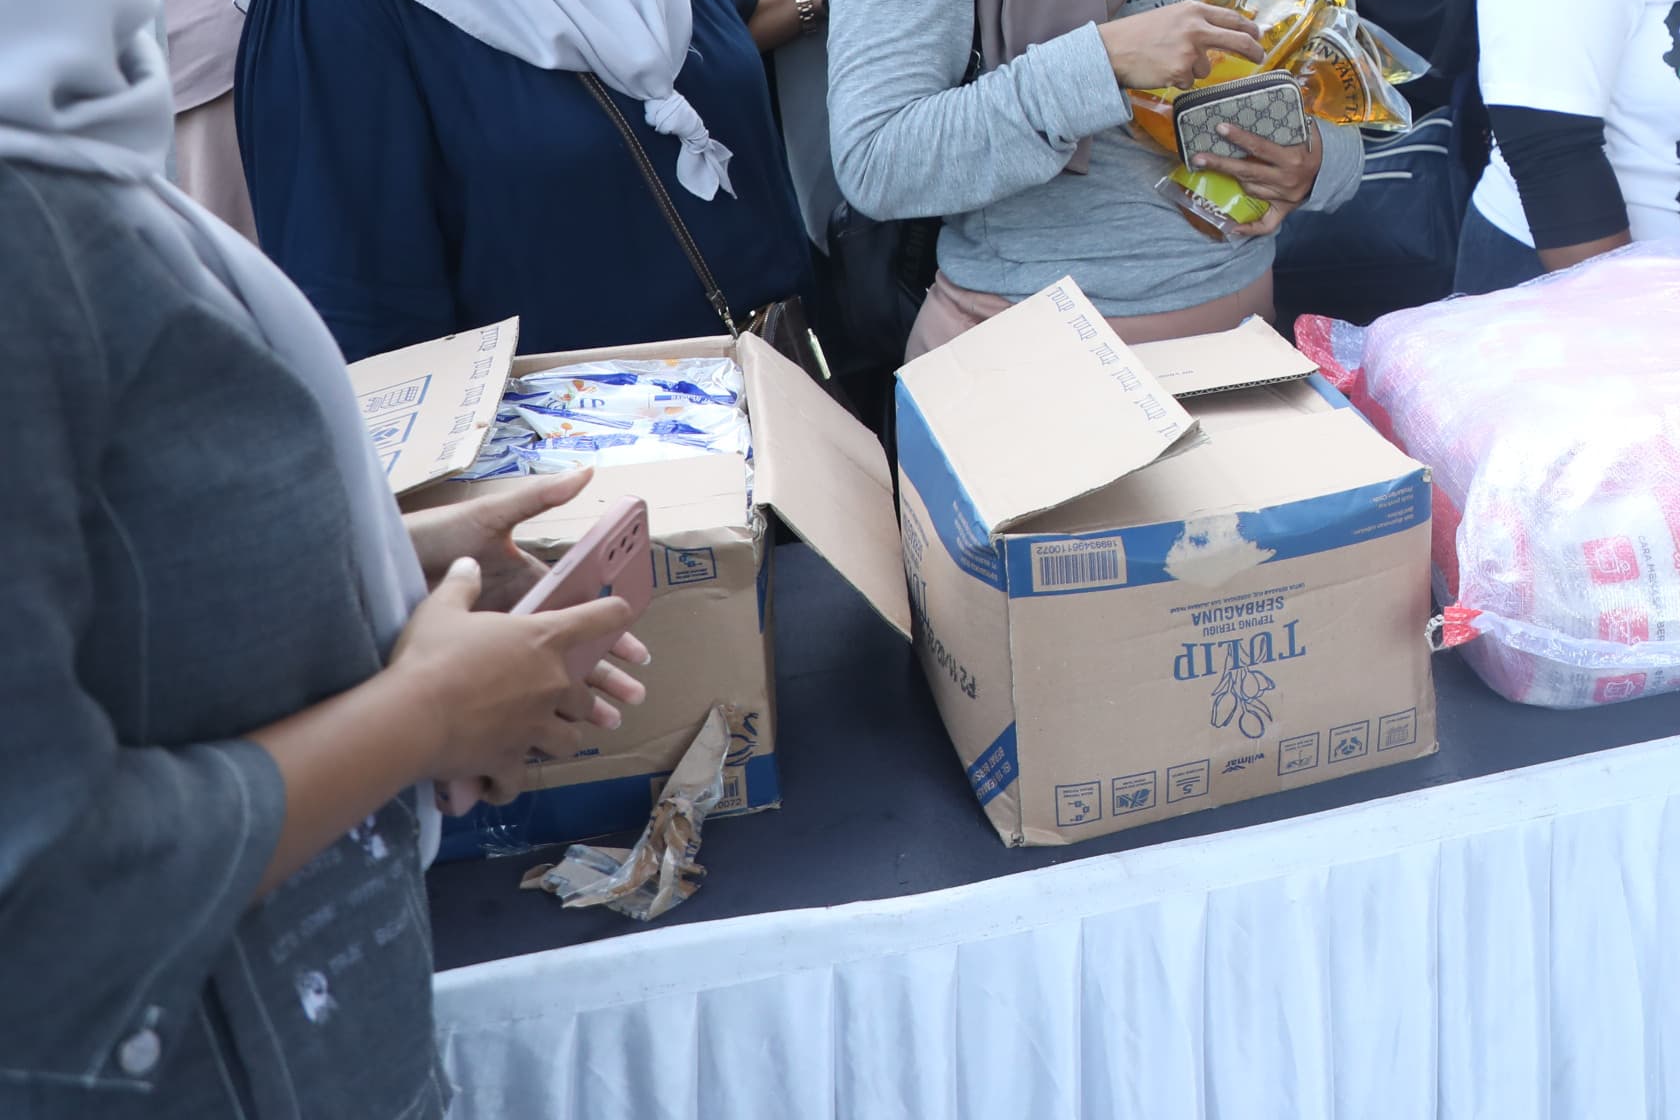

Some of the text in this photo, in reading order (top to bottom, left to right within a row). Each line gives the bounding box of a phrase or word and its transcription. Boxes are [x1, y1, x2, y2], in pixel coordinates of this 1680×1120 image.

[1046, 286, 1074, 312] TULIP
[1067, 312, 1099, 341] TULIP
[1089, 341, 1120, 368] TULIP
[1110, 367, 1143, 395] TULIP
[1133, 394, 1167, 425] TULIP
[1191, 595, 1285, 626] SERBAGUNA
[1202, 614, 1275, 637] TEPUNG TERIGU
[1173, 619, 1307, 681] TULIP
[1225, 753, 1265, 768] wilmar
[1182, 783, 1194, 795] 5
